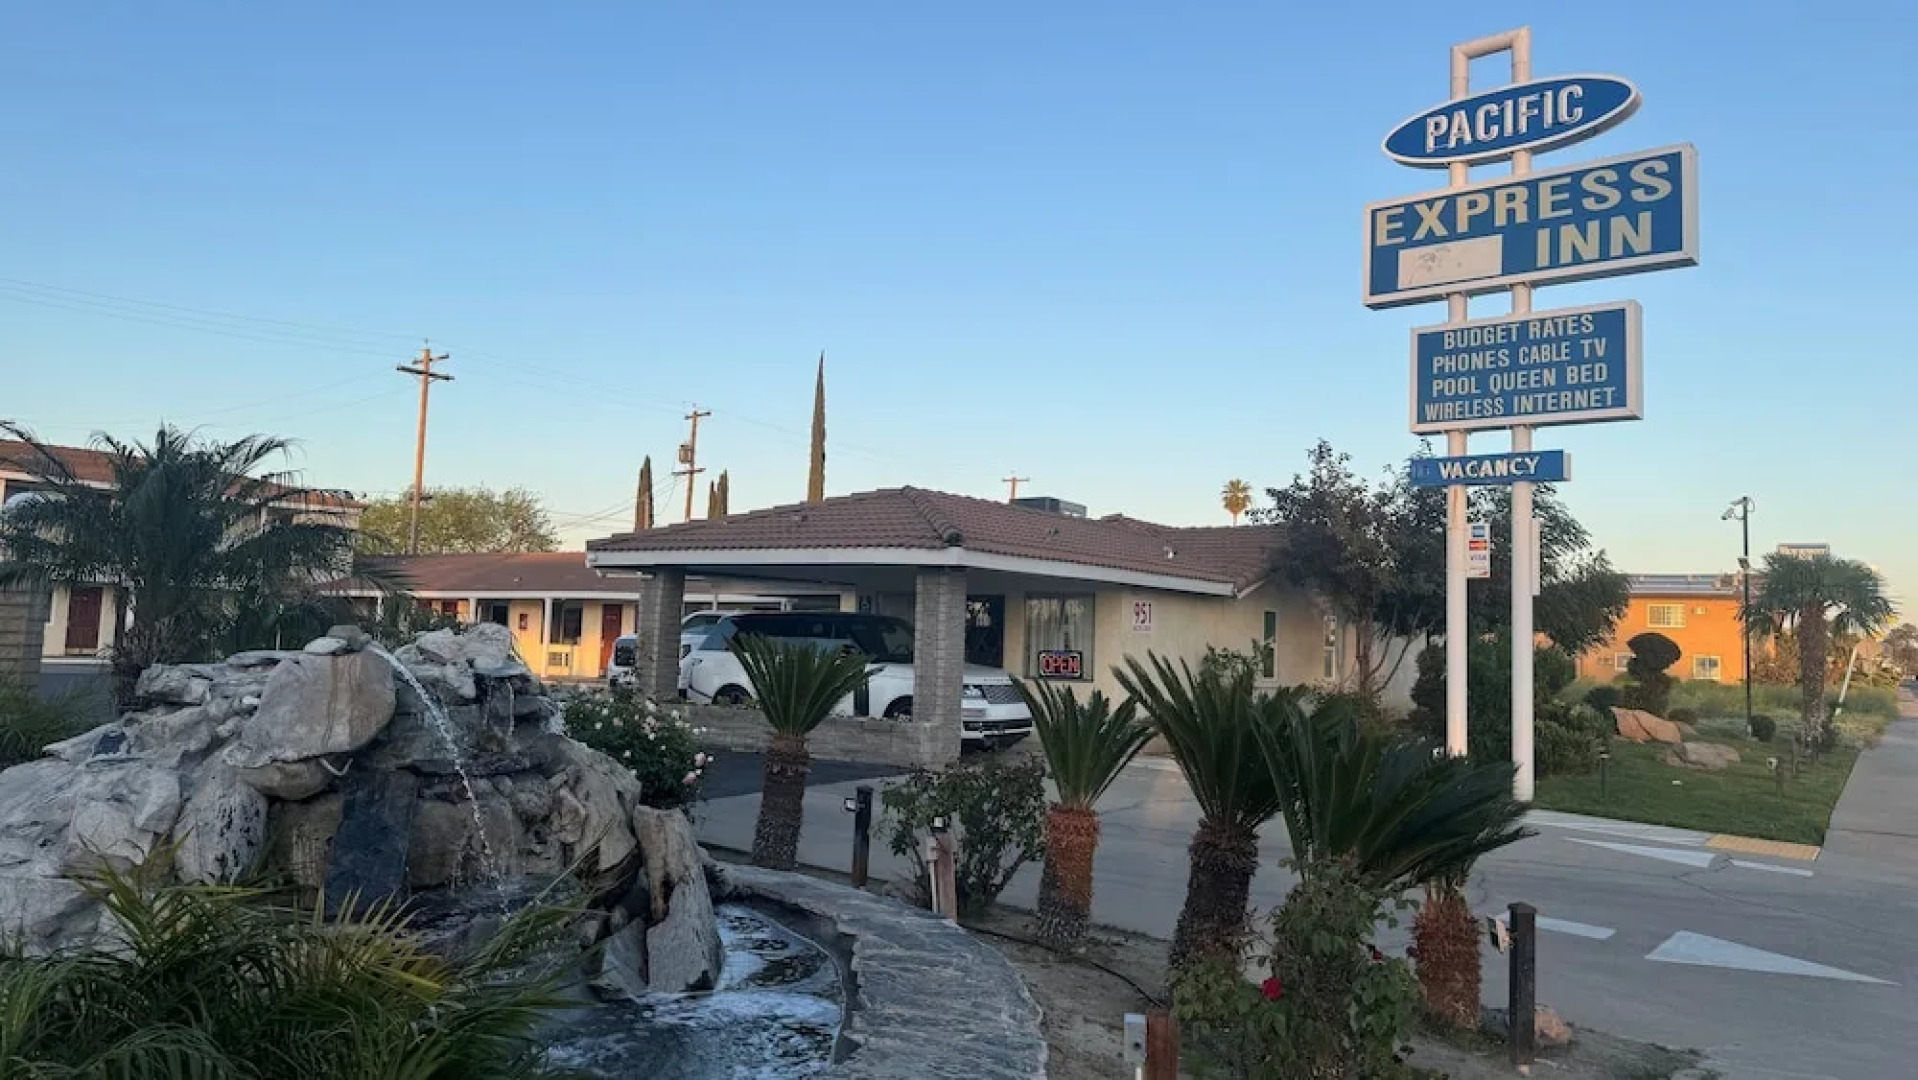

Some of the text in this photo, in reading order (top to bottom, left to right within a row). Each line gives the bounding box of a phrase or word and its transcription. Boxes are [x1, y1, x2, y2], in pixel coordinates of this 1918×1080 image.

[1426, 84, 1584, 154] PACIFIC
[1375, 160, 1672, 247] EXPRESS
[1537, 211, 1652, 268] INN
[1444, 314, 1595, 350] BUDGET RATES
[1433, 337, 1607, 375] PHONES CABLE TV
[1432, 362, 1608, 398] POOL QUEEN BED
[1425, 386, 1617, 421] WIRELESS INTERNET
[1438, 456, 1541, 480] VACANCY
[1133, 601, 1152, 624] 951
[1043, 655, 1080, 674] OPEN
